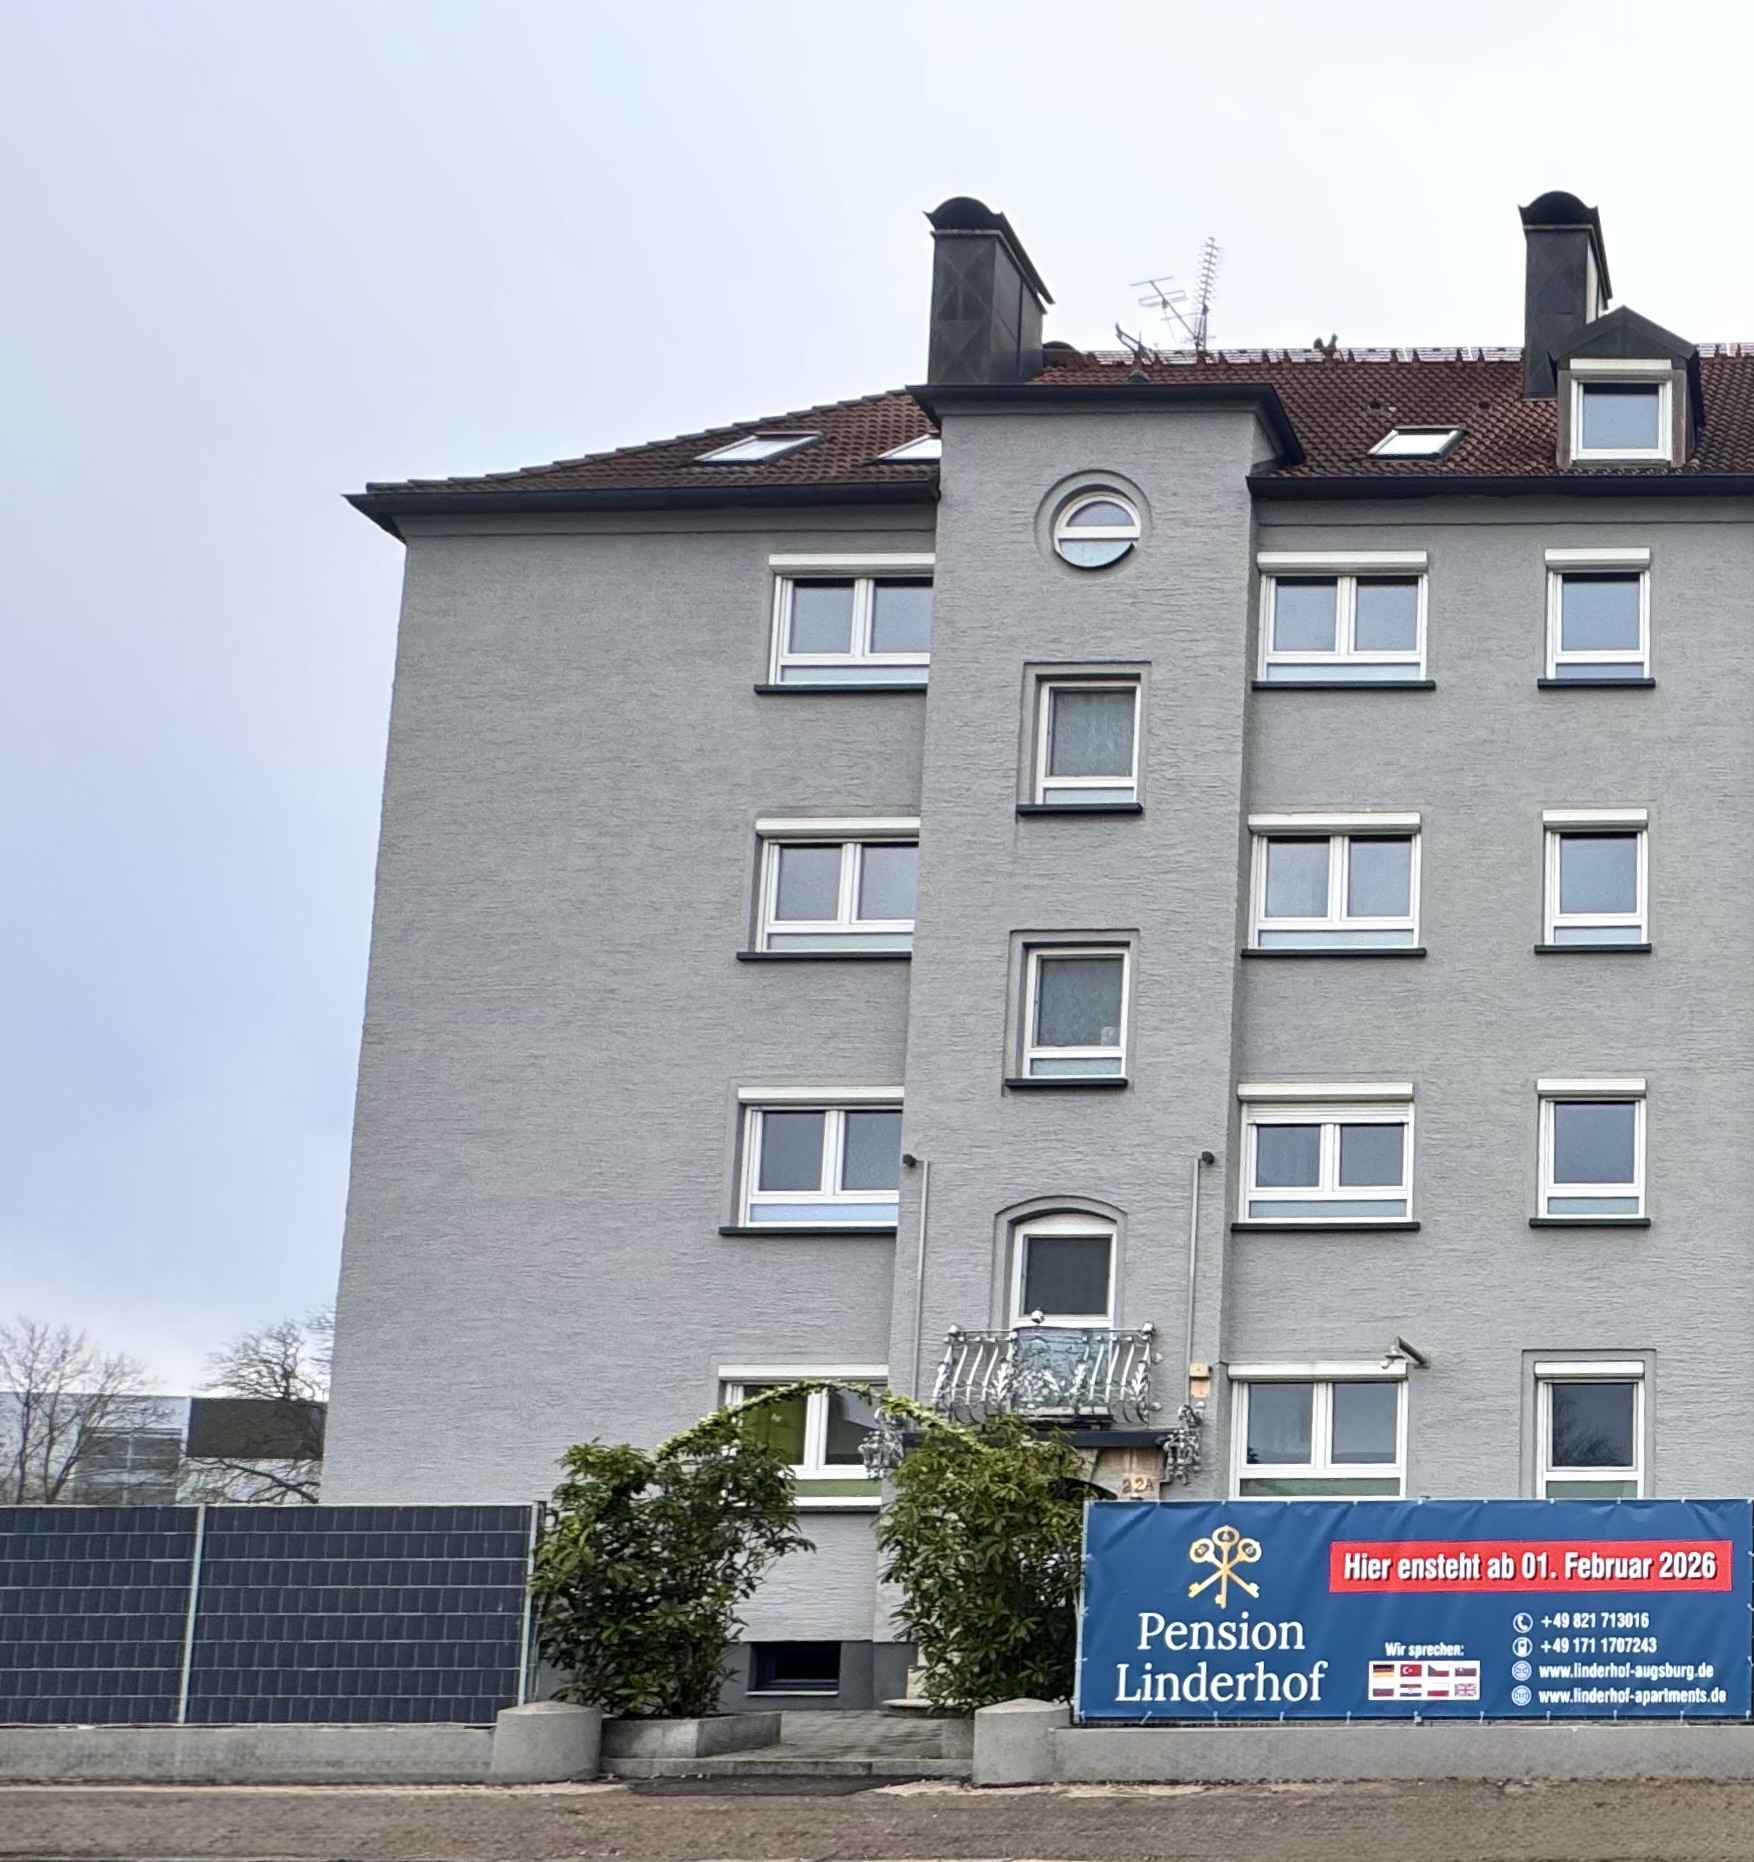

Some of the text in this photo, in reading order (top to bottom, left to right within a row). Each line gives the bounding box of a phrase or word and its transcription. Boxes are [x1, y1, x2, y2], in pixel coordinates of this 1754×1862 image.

[1122, 1477, 1154, 1493] 22A
[1344, 1551, 1716, 1580] Hier ensteht ab 01. Februar 2026
[1541, 1612, 1650, 1629] +49 821 713016
[1137, 1611, 1306, 1651] Pension
[1384, 1642, 1464, 1659] Wir sprechen:
[1540, 1636, 1657, 1654] +49 171 1707243
[1115, 1660, 1329, 1702] Linderhof
[1538, 1662, 1714, 1681] www.linderhof-augsburg.de
[1538, 1687, 1727, 1707] www.linderhof-apartments.de
